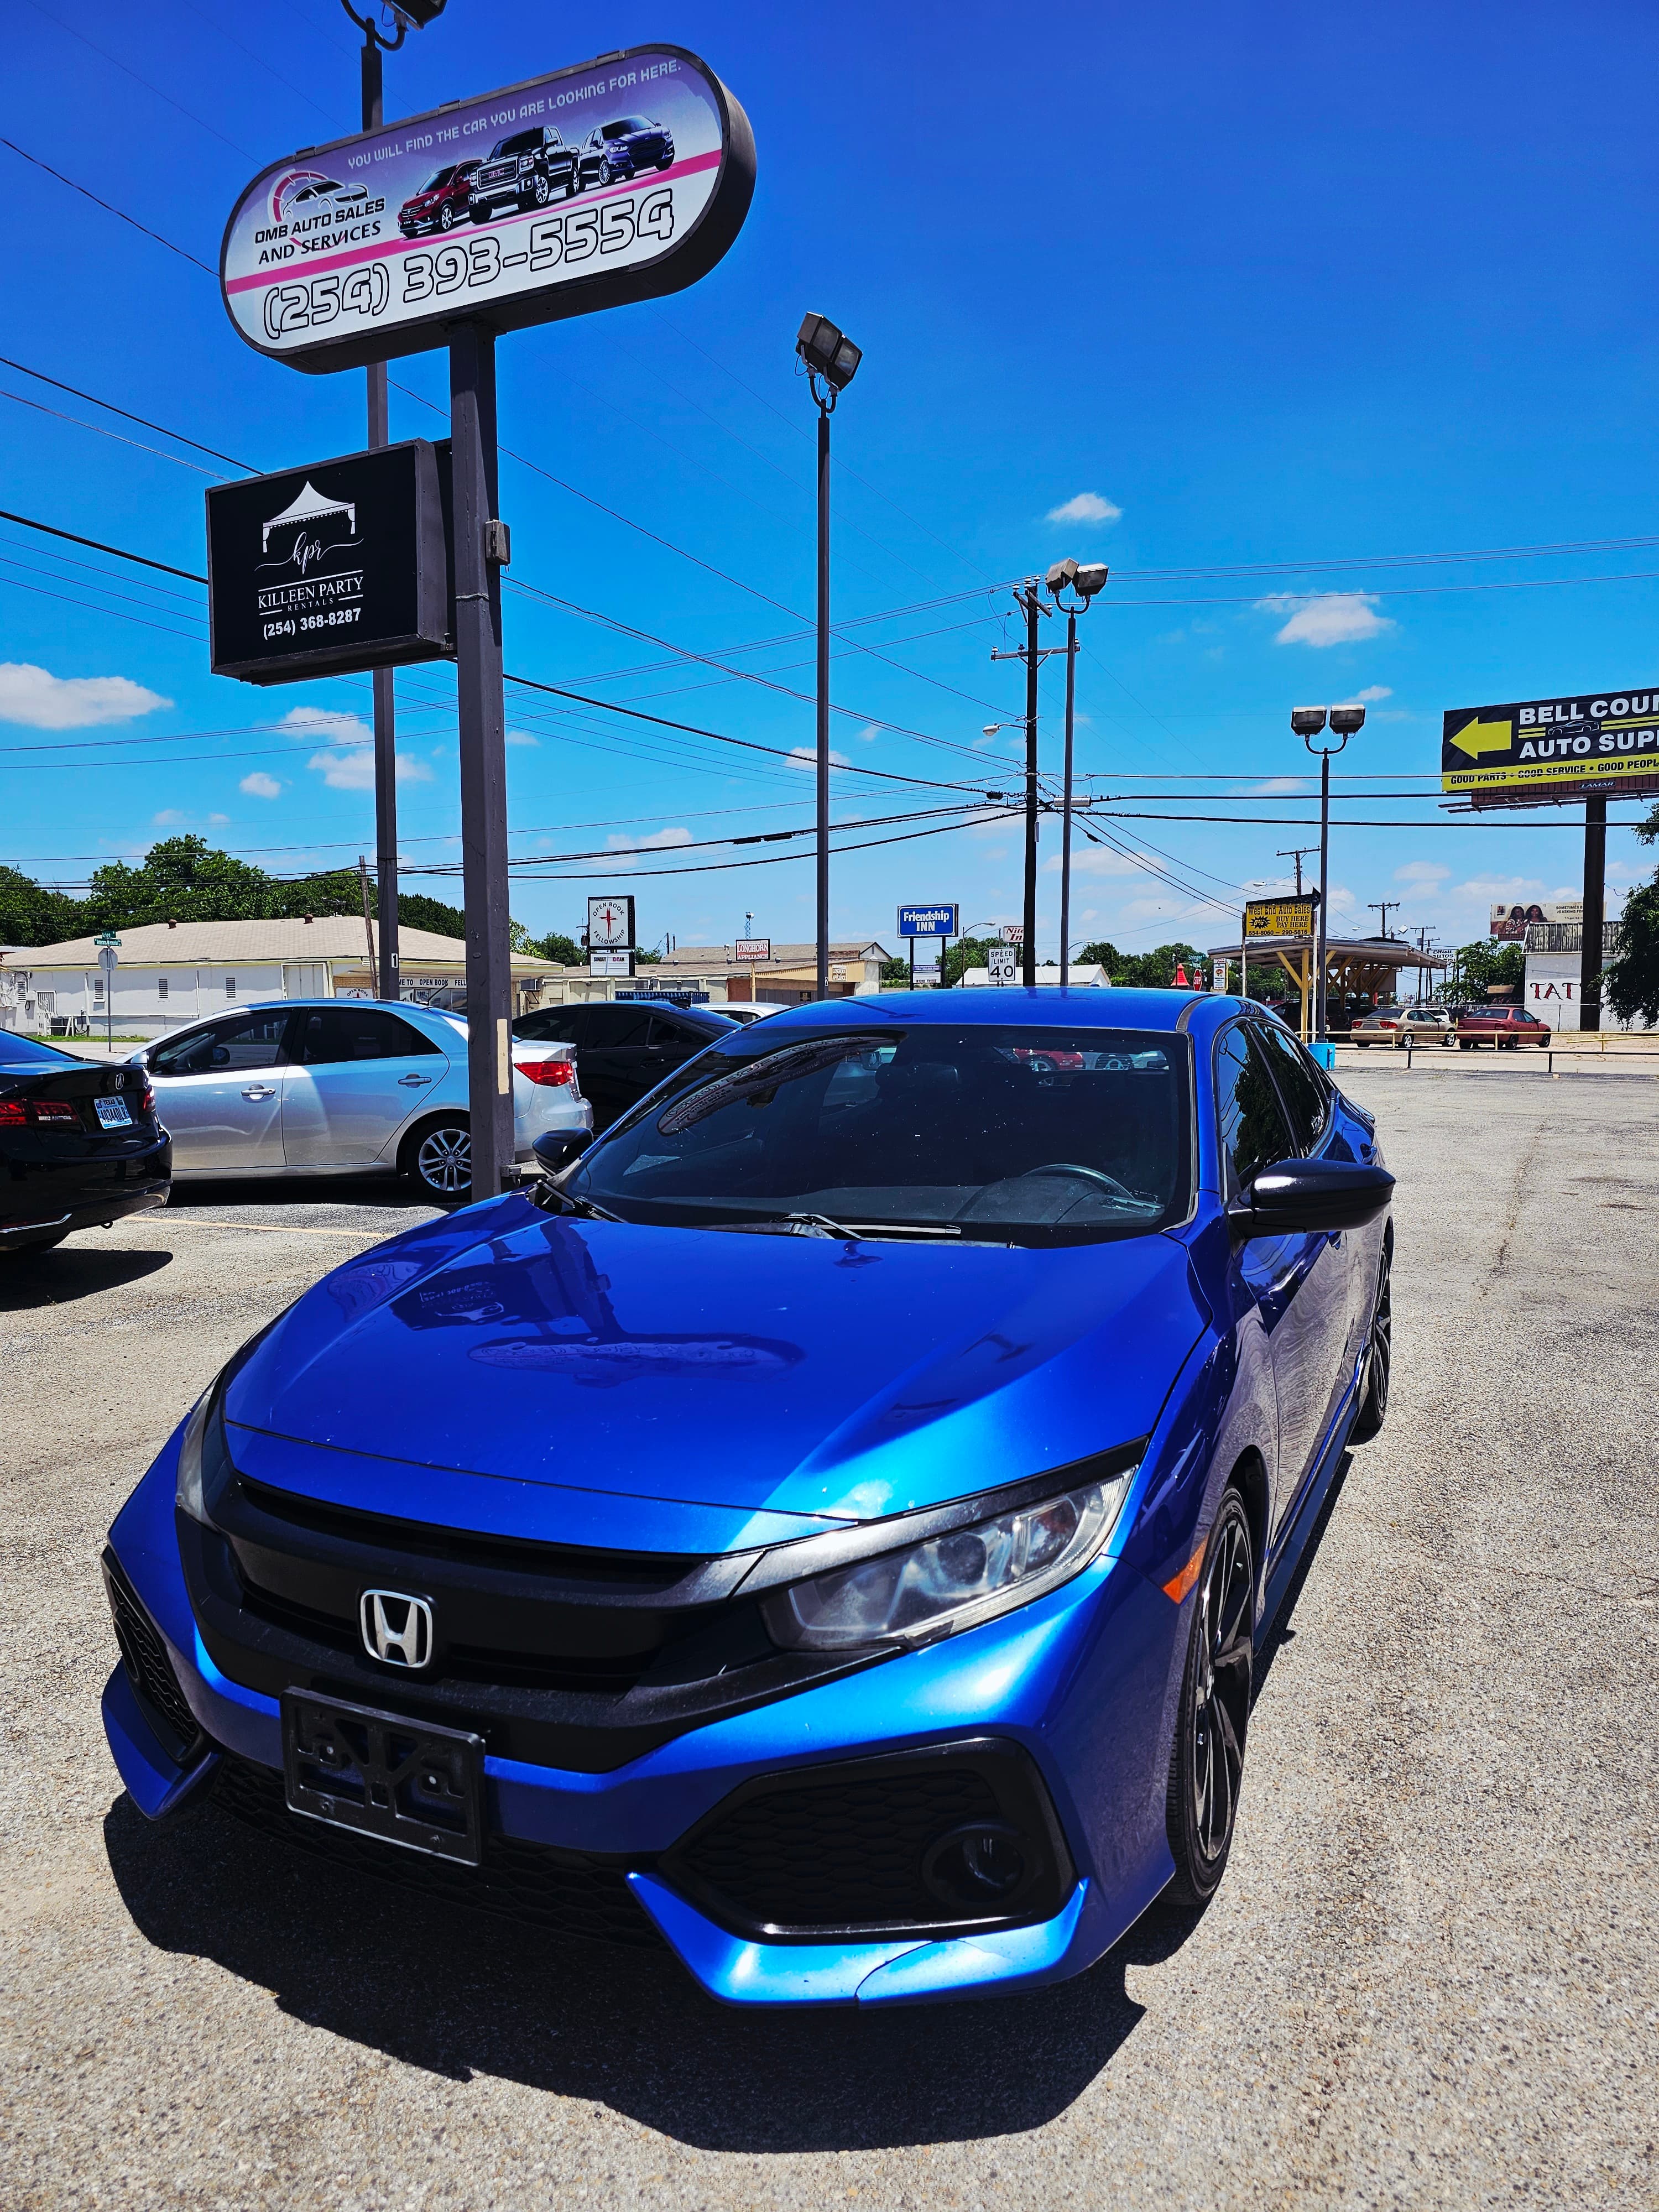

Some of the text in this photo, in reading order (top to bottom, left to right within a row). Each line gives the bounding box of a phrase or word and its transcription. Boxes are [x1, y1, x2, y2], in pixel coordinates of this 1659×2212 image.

[348, 59, 681, 169] YOU WILL FIND THE CAR YOU ARE LOOKING FOR HERE.
[291, 213, 331, 235] AUTO
[335, 198, 385, 223] SALES
[259, 221, 380, 264] AND SERVICES
[263, 189, 674, 340] (254) 393-5554
[258, 576, 364, 608] KILLEEN PARTY
[288, 597, 333, 612] RENTALS
[263, 608, 361, 640] (254) 368-8287
[1520, 703, 1584, 725] BELL
[1519, 730, 1659, 759] AUTO SUP
[1451, 759, 1659, 784] GOOD PARTS GOOD SERVICE GOOD PEOPL
[593, 902, 624, 916] OPEN BOOK
[904, 910, 950, 922] Friendship
[1248, 905, 1310, 915] West End Auto Sales
[916, 921, 935, 932] INN
[593, 929, 625, 945] FELLOWSHIP
[737, 943, 768, 952] LONGHORN
[393, 954, 397, 967] 1
[990, 965, 1014, 978] 40
